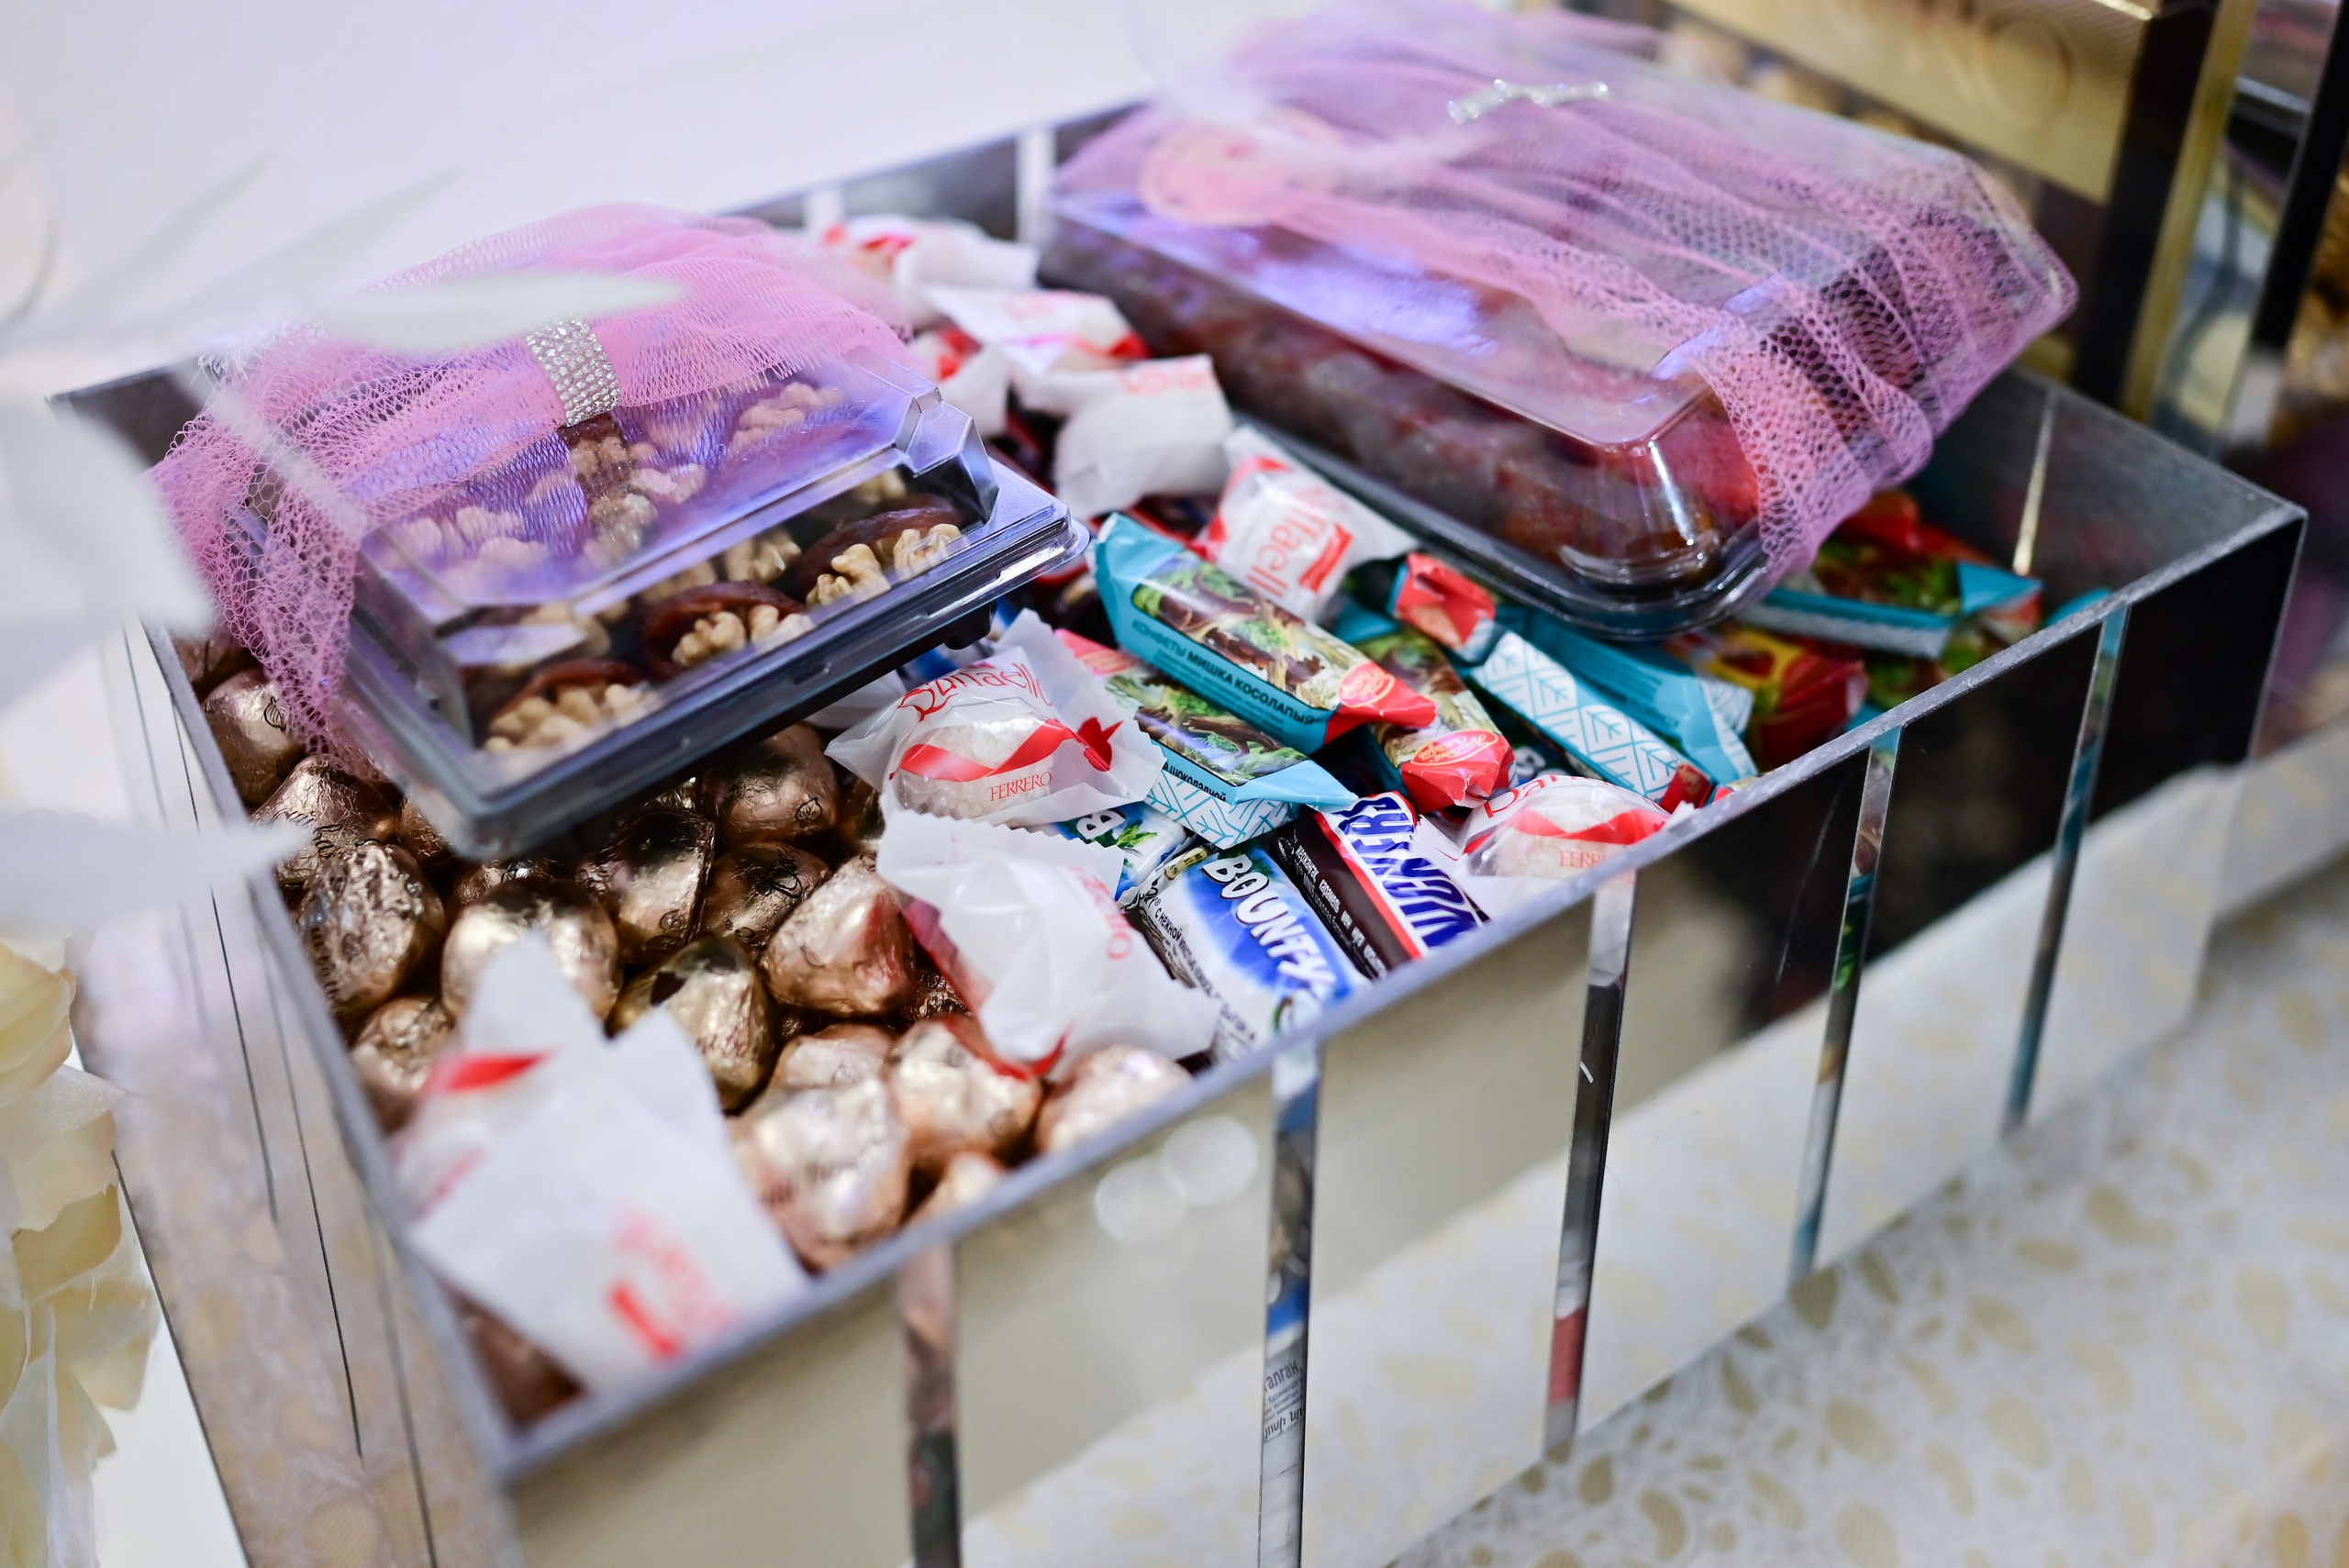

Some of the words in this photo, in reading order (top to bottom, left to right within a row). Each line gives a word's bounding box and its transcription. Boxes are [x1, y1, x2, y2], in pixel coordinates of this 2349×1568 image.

[1186, 651, 1233, 685] МИШКА
[990, 771, 1052, 802] FERRERO
[1158, 912, 1183, 941] нежной
[1202, 854, 1336, 988] BOUNTY
